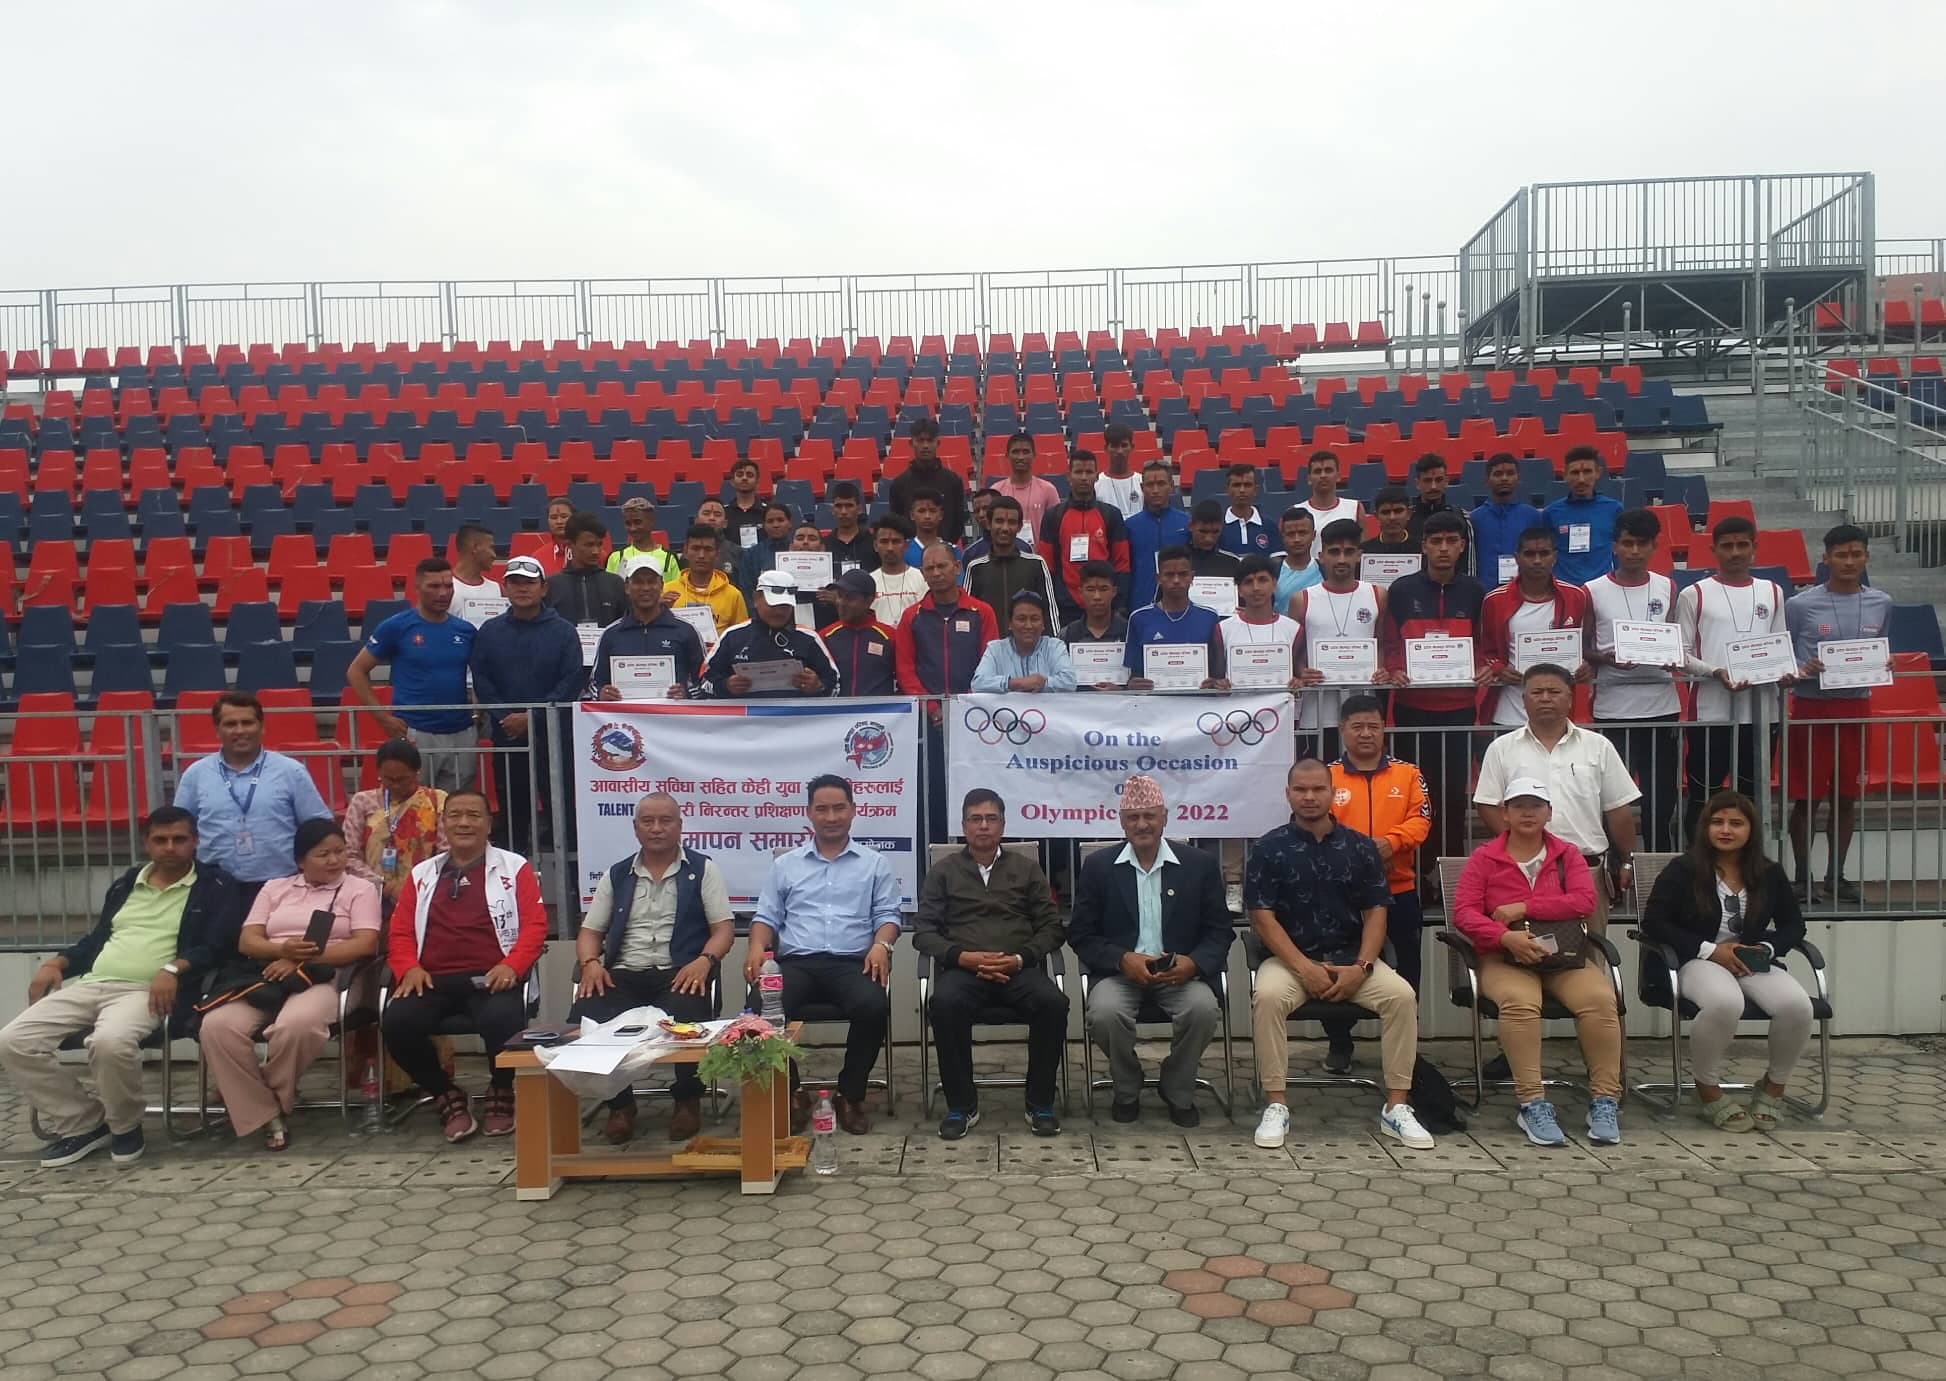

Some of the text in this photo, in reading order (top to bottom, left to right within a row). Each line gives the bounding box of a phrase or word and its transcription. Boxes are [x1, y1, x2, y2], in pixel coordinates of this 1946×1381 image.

[1084, 731, 1161, 746] On the
[1006, 753, 1239, 774] Auspicious Occasion
[590, 777, 650, 793] आवासीय
[699, 778, 737, 795] सहित
[776, 782, 801, 797] युवा
[598, 803, 635, 816] TALENT
[1021, 804, 1229, 824] Olympic 2022
[681, 832, 742, 850] मापन
